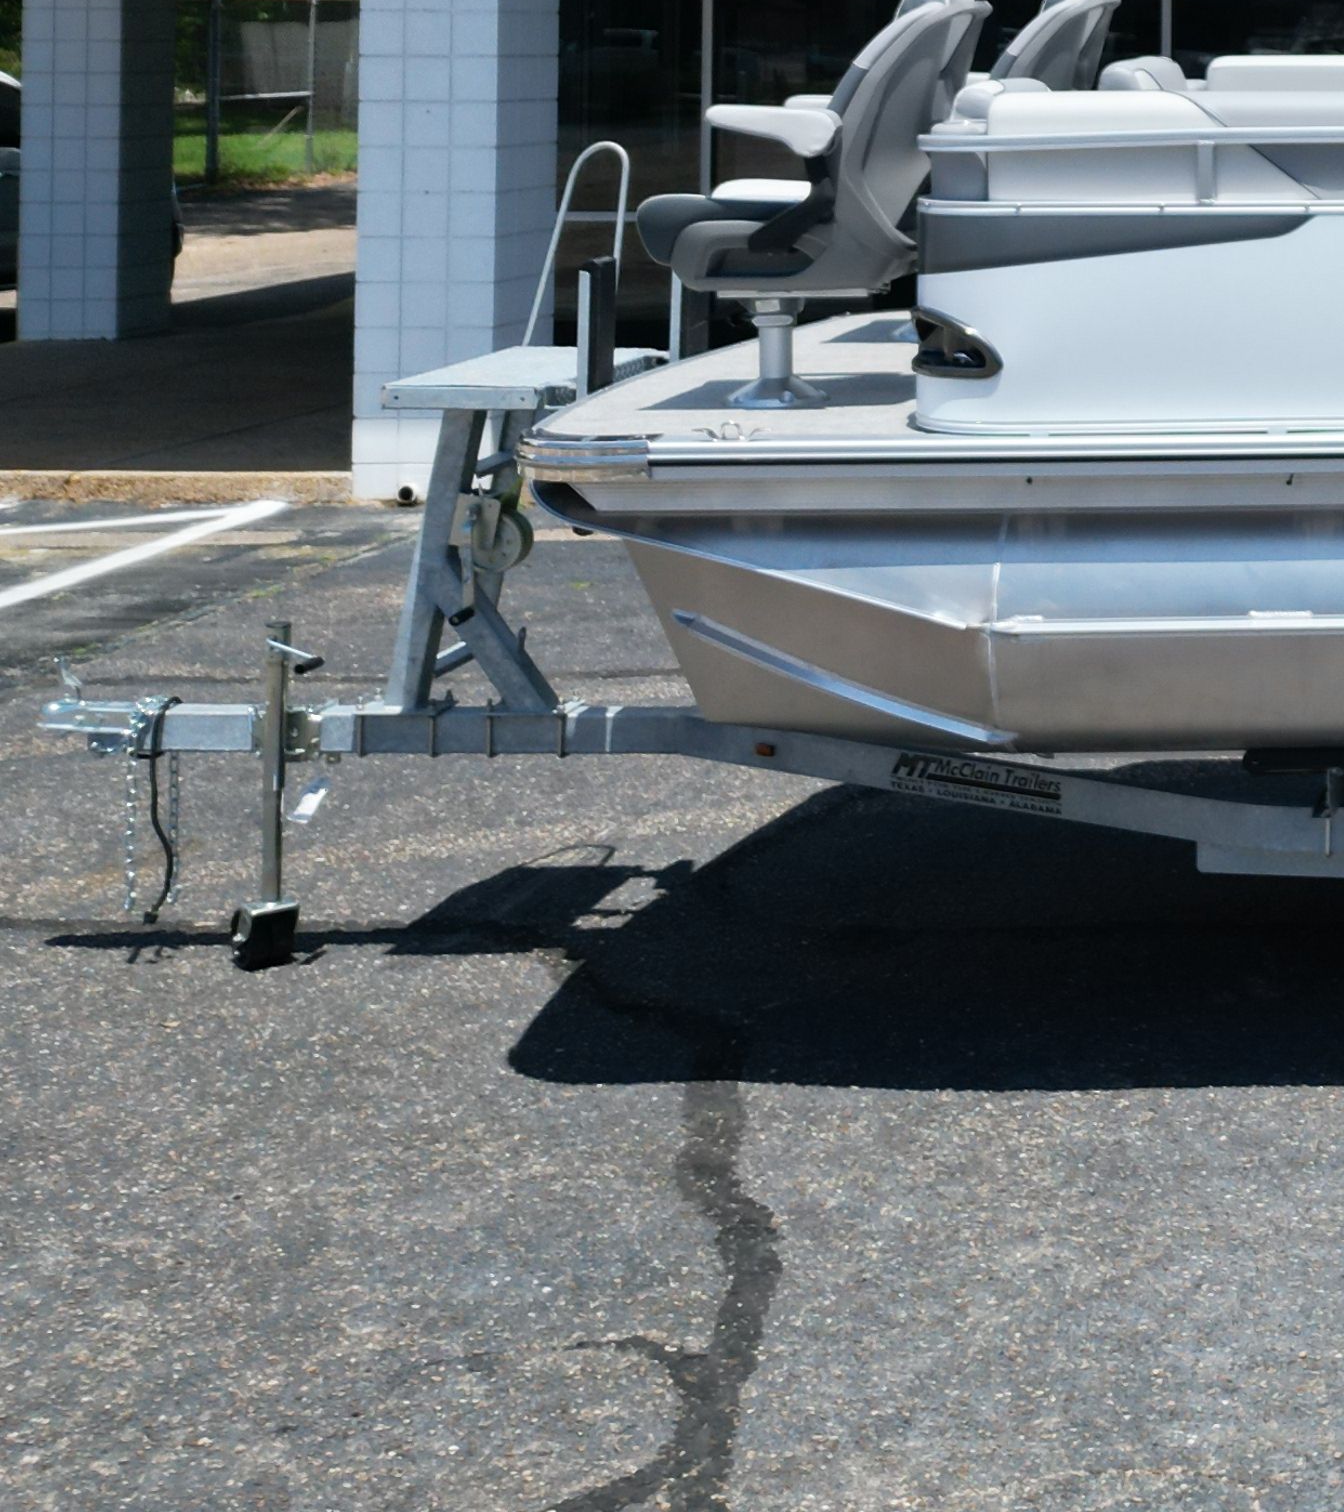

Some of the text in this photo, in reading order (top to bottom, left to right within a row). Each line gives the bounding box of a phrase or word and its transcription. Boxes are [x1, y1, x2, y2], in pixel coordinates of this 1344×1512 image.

[934, 759, 1000, 783] McClain
[1004, 769, 1062, 793] Trailers
[892, 781, 926, 794] TEXAS
[936, 789, 997, 805] LOUISIANA
[1009, 800, 1063, 816] ALABAMA
